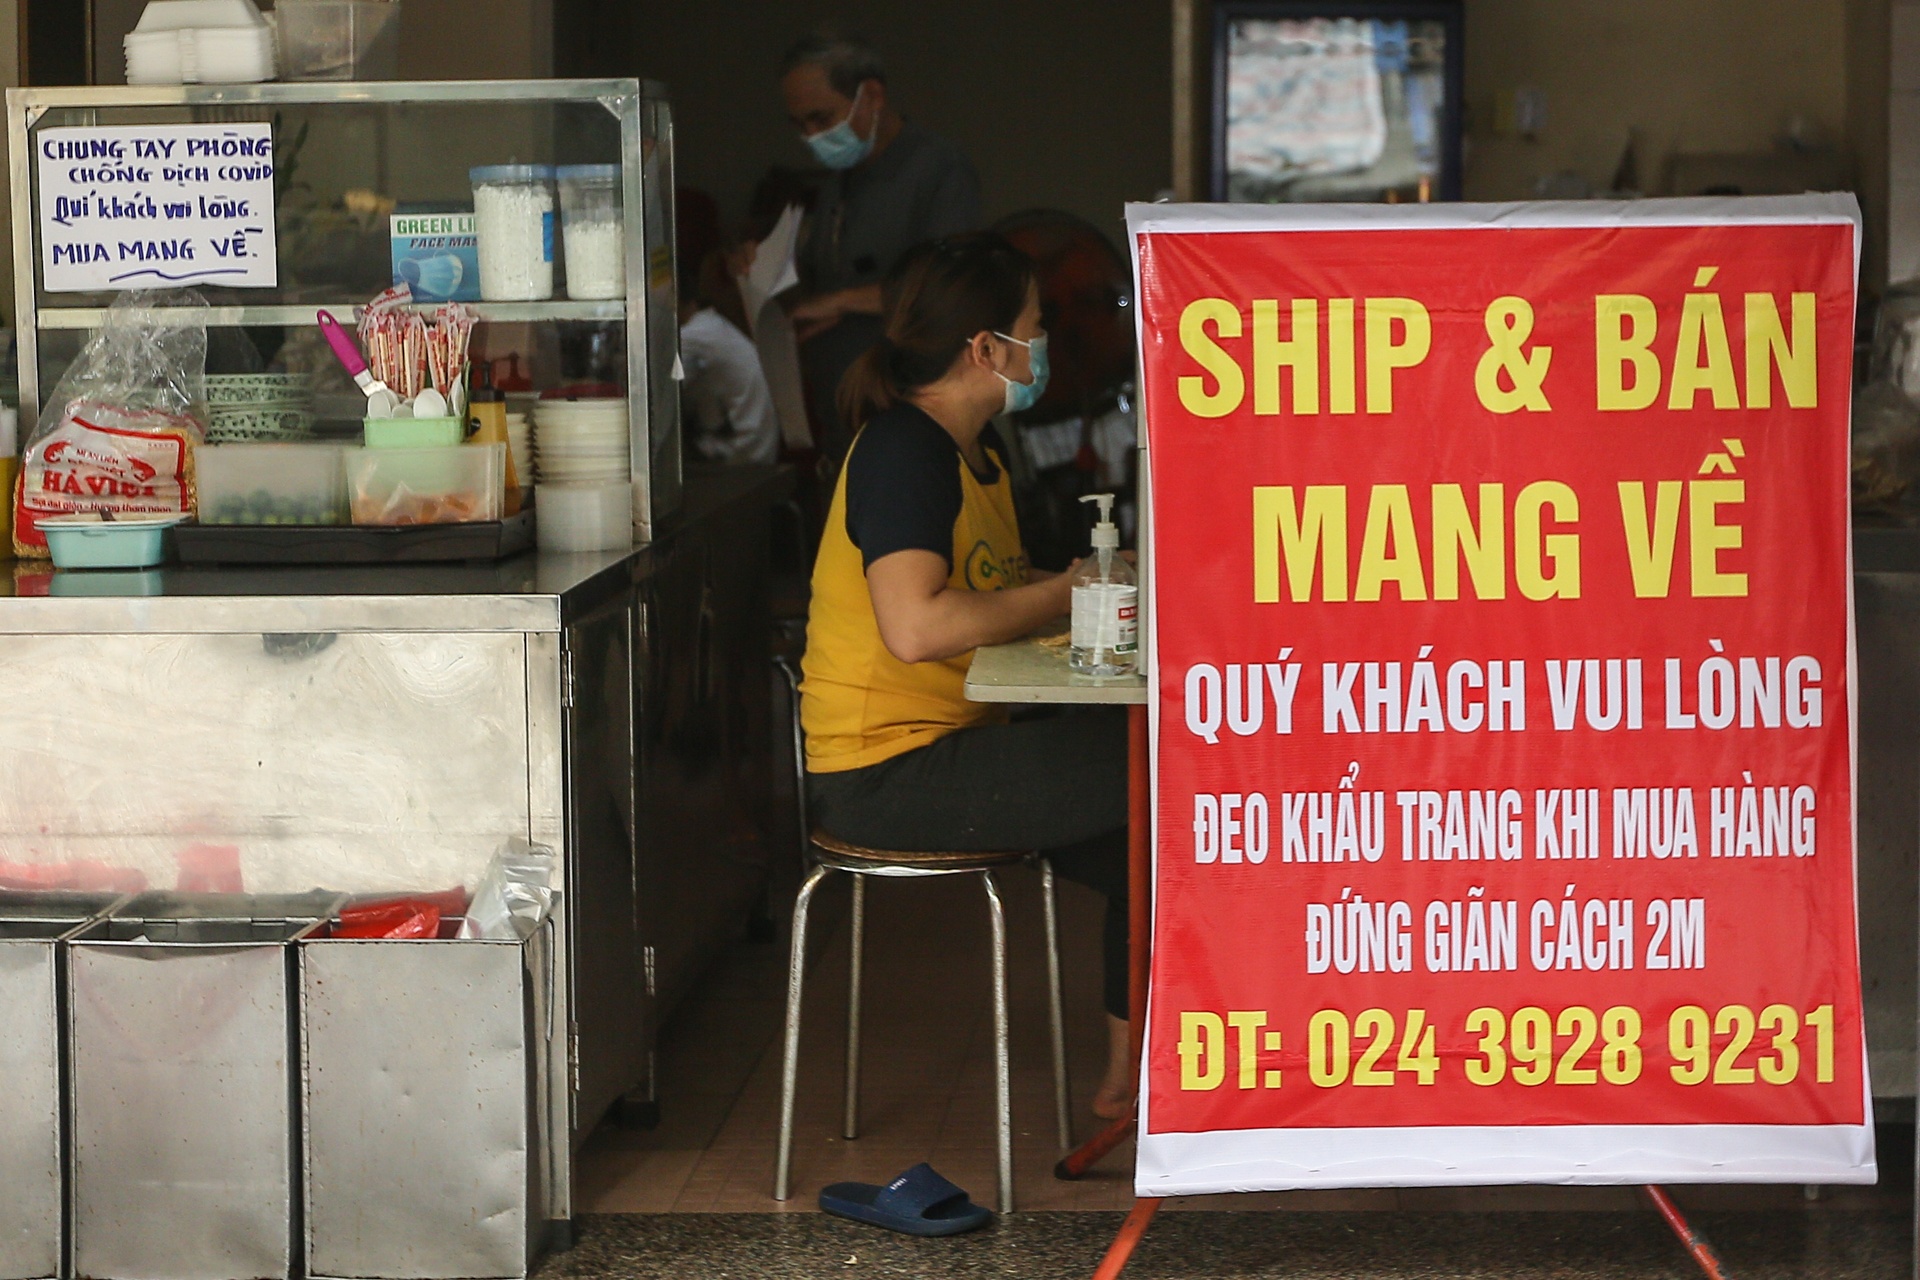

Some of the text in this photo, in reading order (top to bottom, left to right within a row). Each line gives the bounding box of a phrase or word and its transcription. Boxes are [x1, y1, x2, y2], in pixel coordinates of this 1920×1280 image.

[43, 138, 127, 160] CHUNG
[131, 138, 176, 159] TAY
[68, 160, 273, 187] CHỐNG DỊCH COVID
[99, 191, 157, 220] khách
[397, 218, 453, 234] GREEN
[53, 243, 110, 266] MUA
[118, 238, 195, 261] MANG
[410, 237, 446, 249] FACE
[1178, 266, 1818, 418] SHIP & BÁN
[1253, 438, 1749, 604] MANG VỀ
[1184, 638, 1823, 745] QUÝ KHÁCH VUI LÒNG
[1192, 761, 1816, 865] ĐEO KHẨU TRANG KHI MUA HÀNG
[1304, 883, 1705, 974] ĐỨNG GIÃN CÁCH 2M
[1176, 1003, 1834, 1091] ĐT: 024 3928 9231
